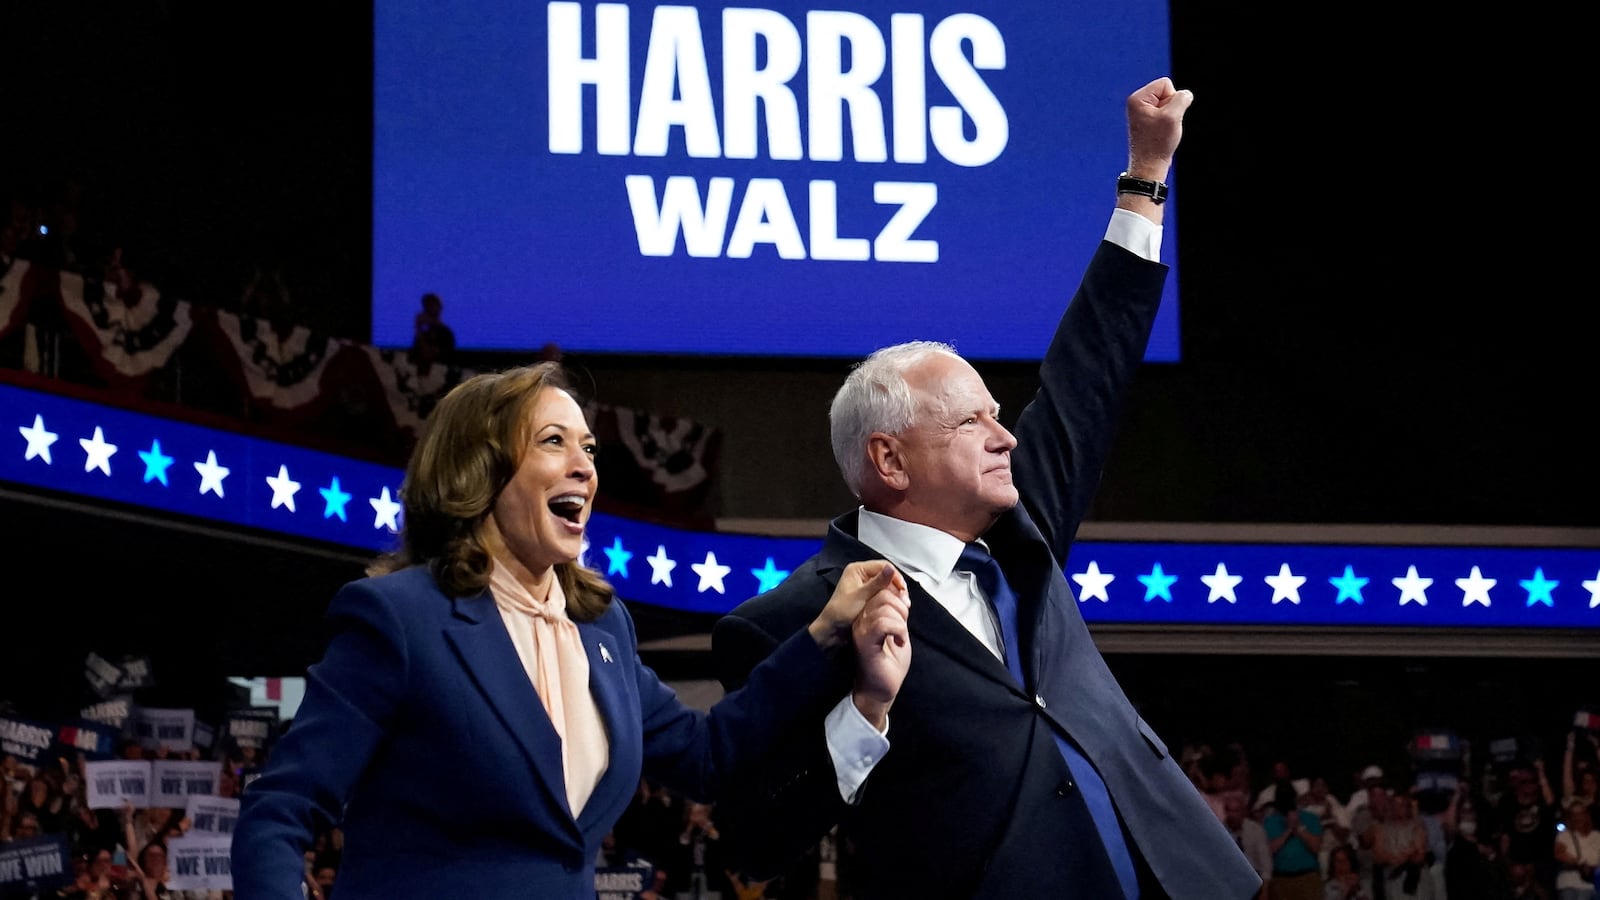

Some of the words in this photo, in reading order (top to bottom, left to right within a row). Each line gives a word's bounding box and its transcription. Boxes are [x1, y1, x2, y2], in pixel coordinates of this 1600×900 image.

[547, 1, 1010, 168] HARRIS
[624, 174, 940, 263] WALZ
[96, 779, 117, 795] WE
[120, 779, 146, 795] WIN
[161, 778, 182, 795] WE
[186, 779, 213, 795] WIN
[24, 852, 62, 878] WIN
[175, 856, 200, 875] WE
